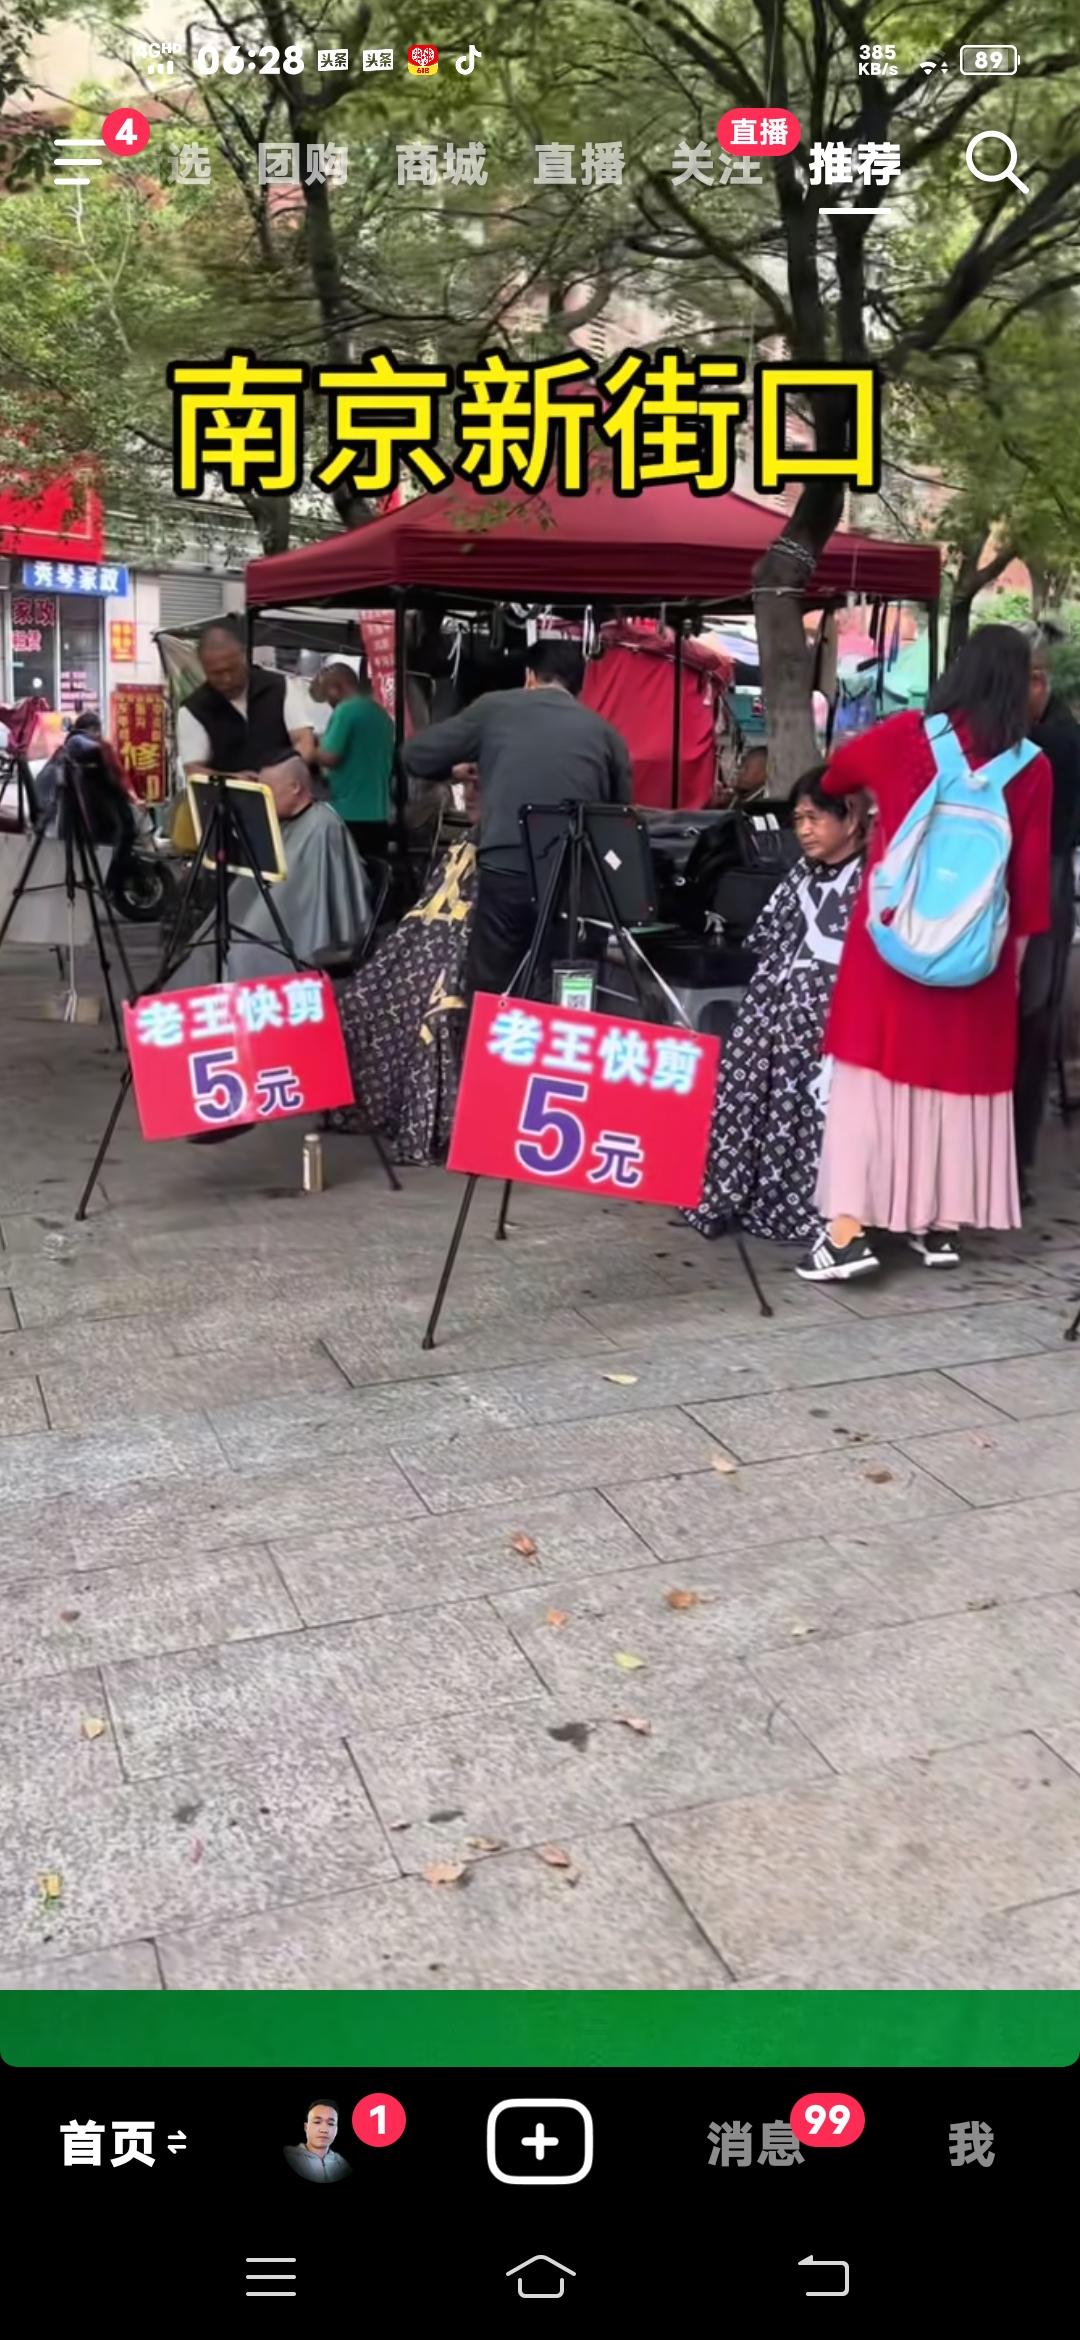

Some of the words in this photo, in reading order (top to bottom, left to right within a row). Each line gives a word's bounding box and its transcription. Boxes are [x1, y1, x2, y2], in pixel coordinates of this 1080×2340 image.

[136, 979, 324, 1046] 老王快剪
[487, 1008, 703, 1094] 老王快剪
[188, 1046, 304, 1123] 5元
[514, 1073, 645, 1189] 5元
